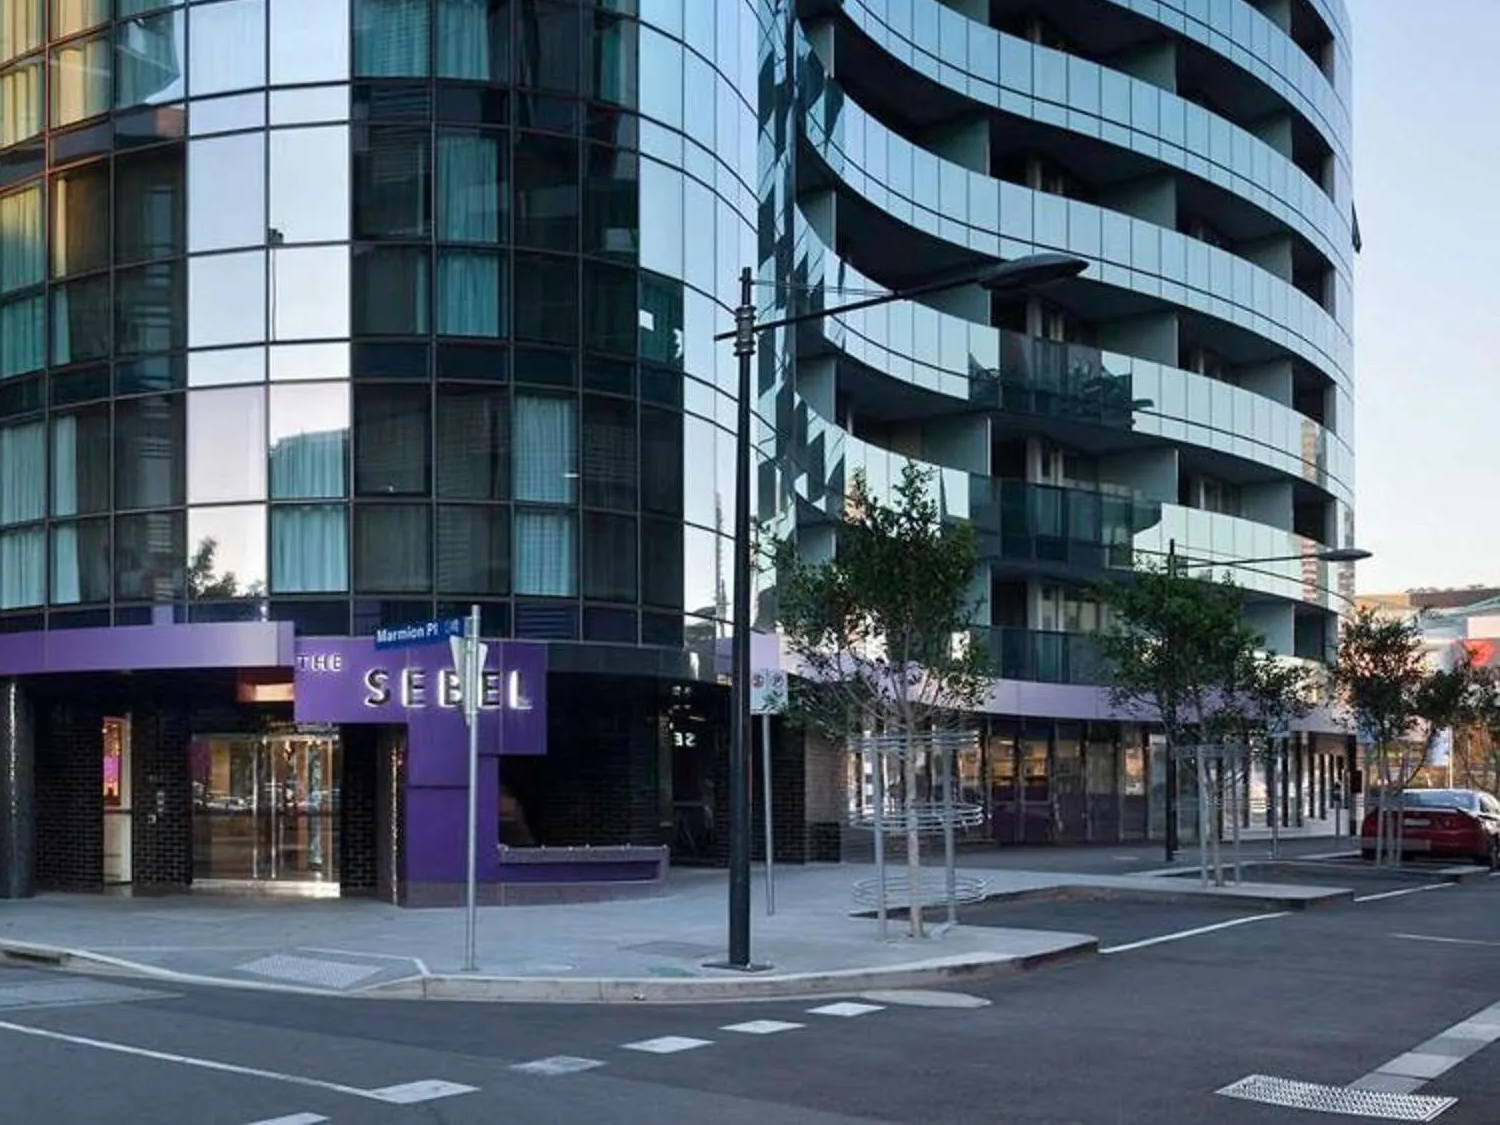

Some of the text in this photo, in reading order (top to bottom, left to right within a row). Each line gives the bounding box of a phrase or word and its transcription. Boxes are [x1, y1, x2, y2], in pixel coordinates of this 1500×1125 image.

[376, 625, 425, 643] Marmion
[426, 622, 439, 636] Pl
[296, 654, 342, 672] THE
[364, 668, 533, 710] SEBEL
